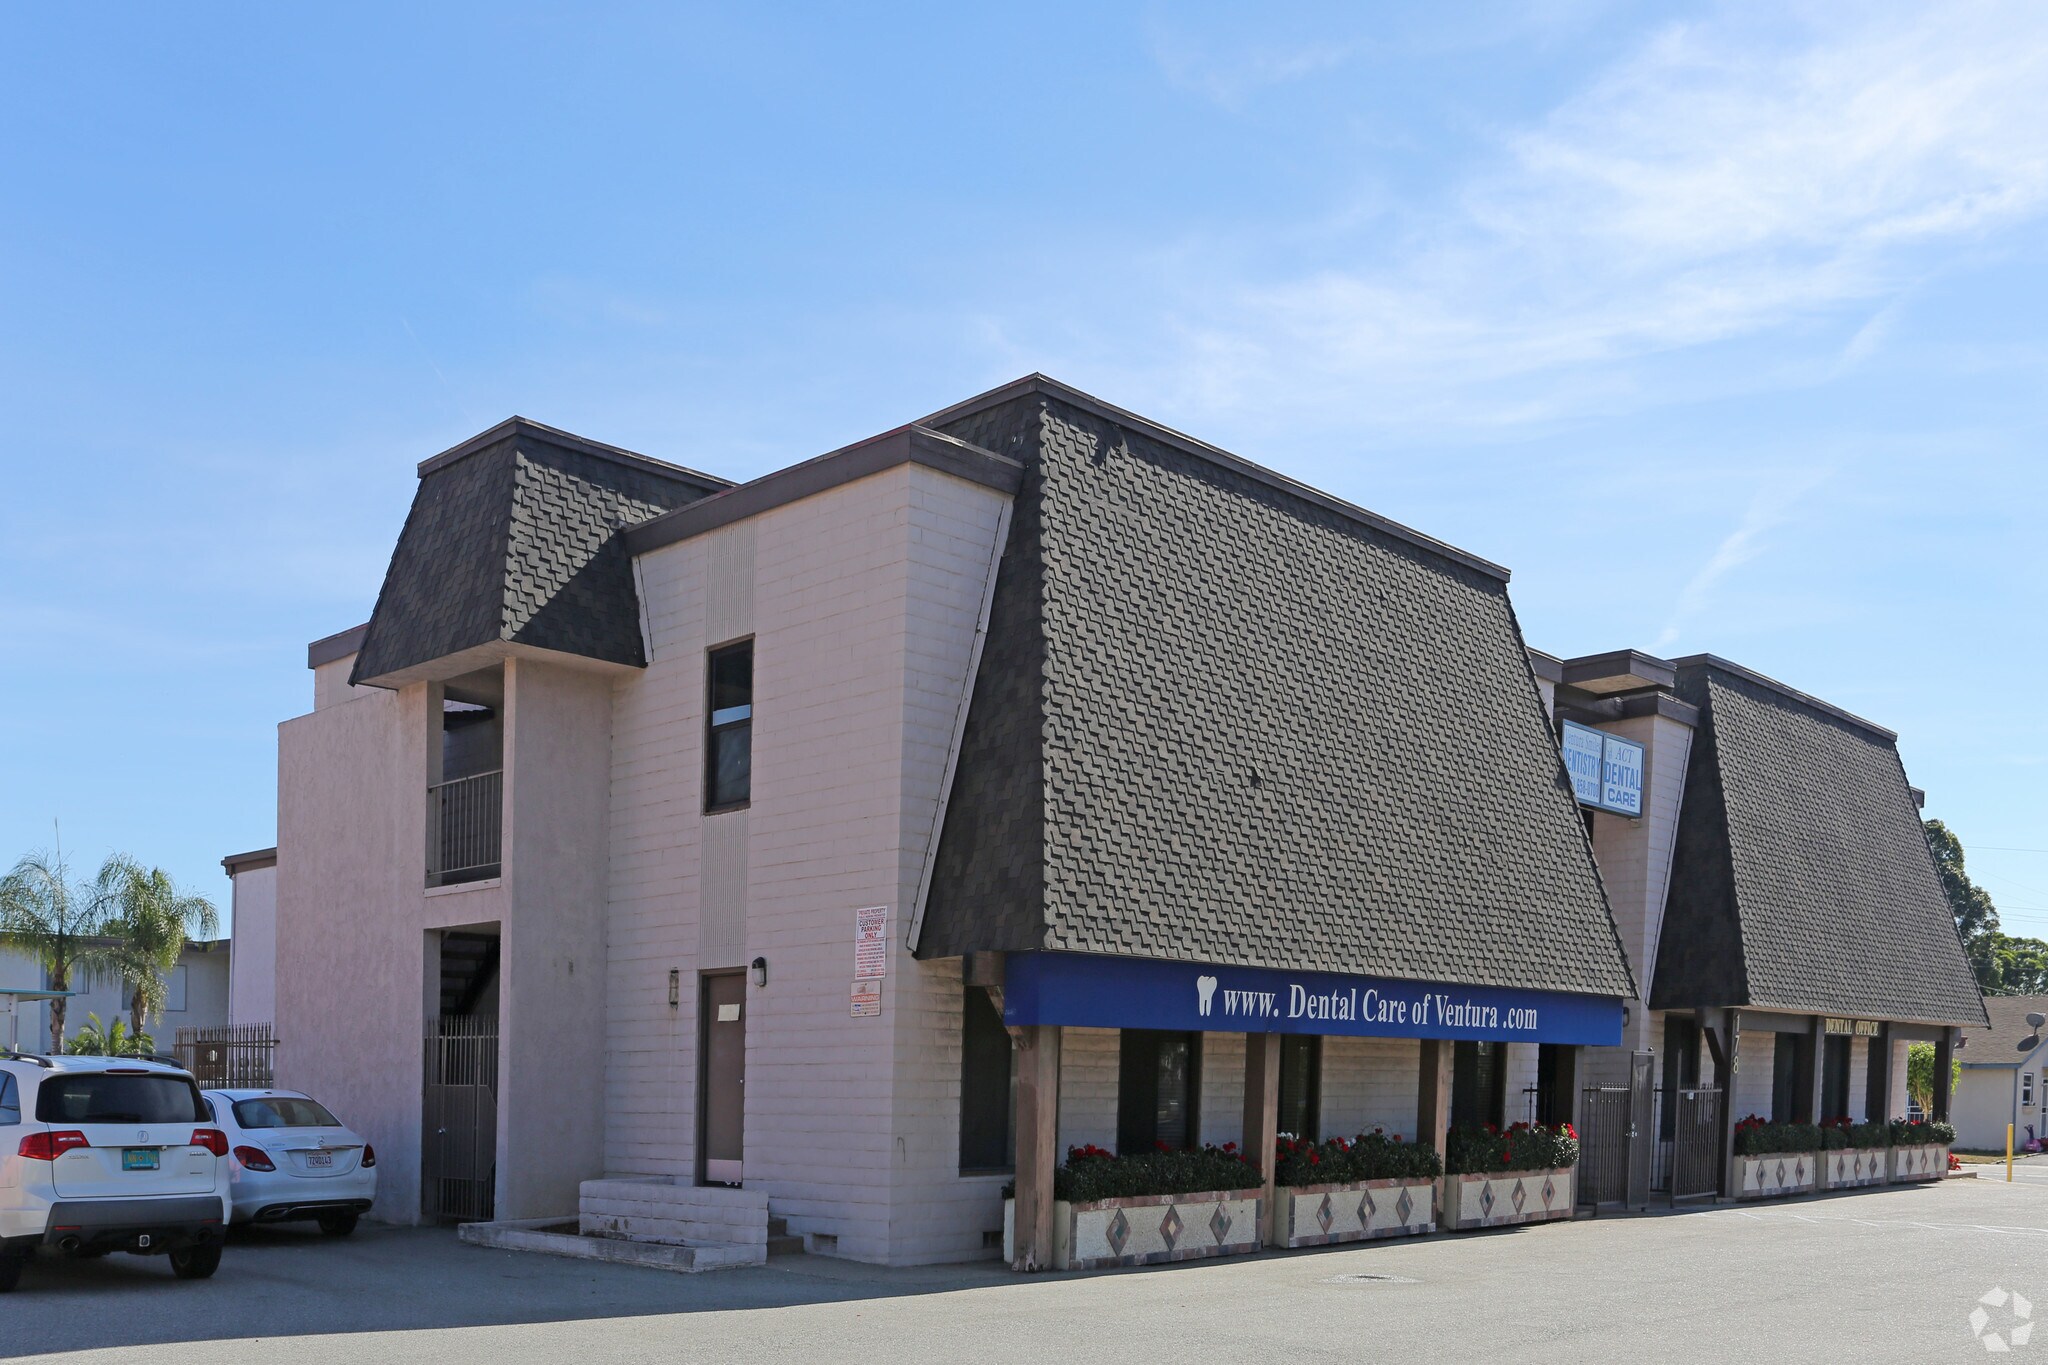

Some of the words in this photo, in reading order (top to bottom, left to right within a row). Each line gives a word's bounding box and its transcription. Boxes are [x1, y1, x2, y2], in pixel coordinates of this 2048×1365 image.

[1563, 747, 1601, 780] DENTISTRY
[1616, 745, 1634, 764] ACT
[1604, 761, 1641, 791] DENTAL
[1608, 787, 1636, 807] CARE
[859, 918, 884, 927] CUSTOMER
[865, 931, 878, 939] ONLY
[851, 994, 880, 1002] WARNING
[1223, 990, 1279, 1018] www.
[1287, 984, 1356, 1021] Dental
[1362, 989, 1406, 1024] Care
[1411, 993, 1431, 1025] of
[1434, 994, 1498, 1028] Ventura
[1502, 1007, 1538, 1030] .com
[1825, 1018, 1852, 1034] DENTAL
[1855, 1020, 1879, 1036] OFFICE
